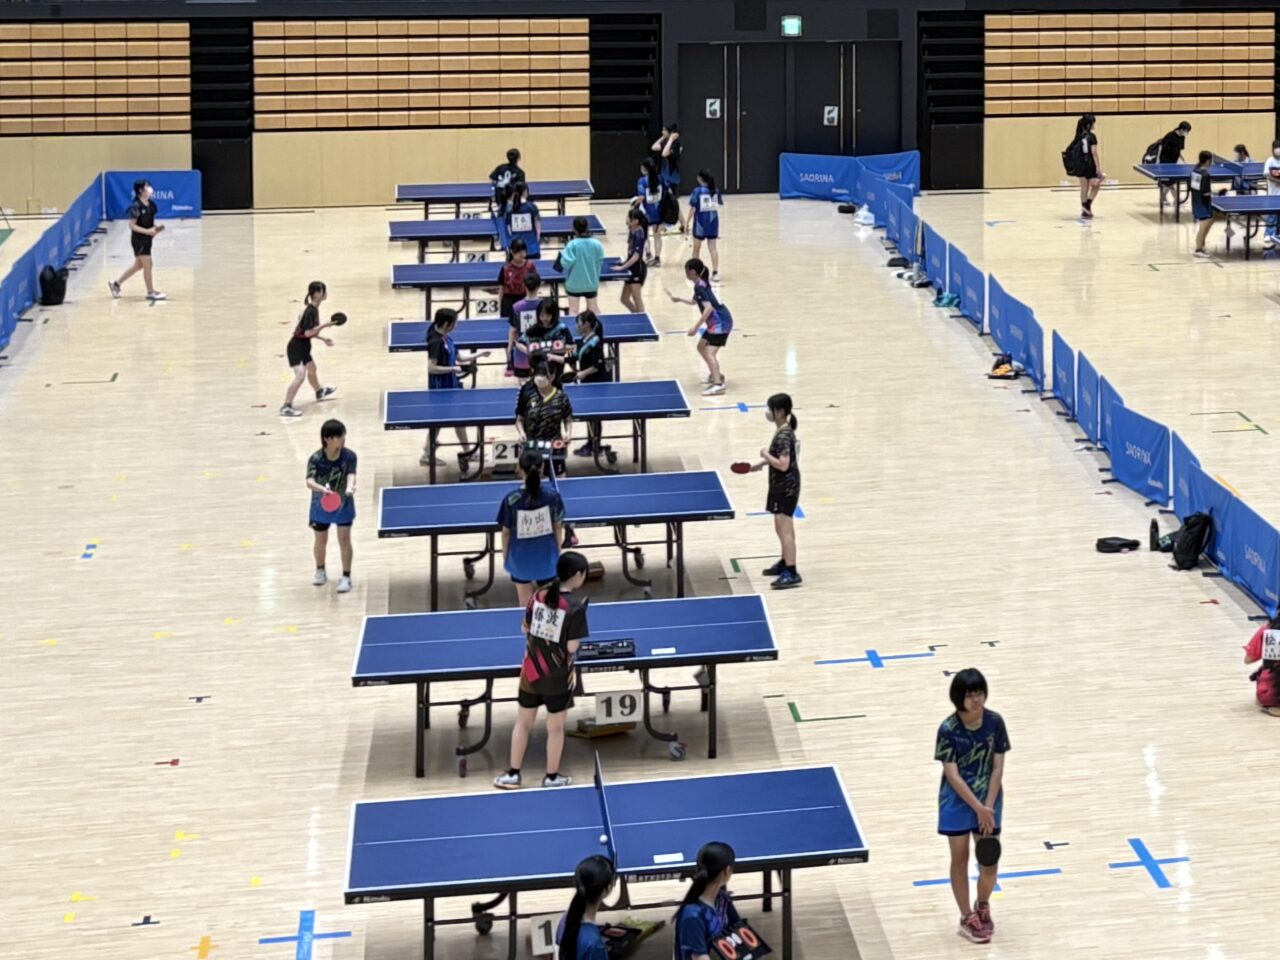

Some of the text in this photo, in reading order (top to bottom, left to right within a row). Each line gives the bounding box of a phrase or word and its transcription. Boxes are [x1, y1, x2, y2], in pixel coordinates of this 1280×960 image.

[477, 300, 498, 314] 23
[495, 444, 518, 459] 21
[600, 693, 638, 720] 19
